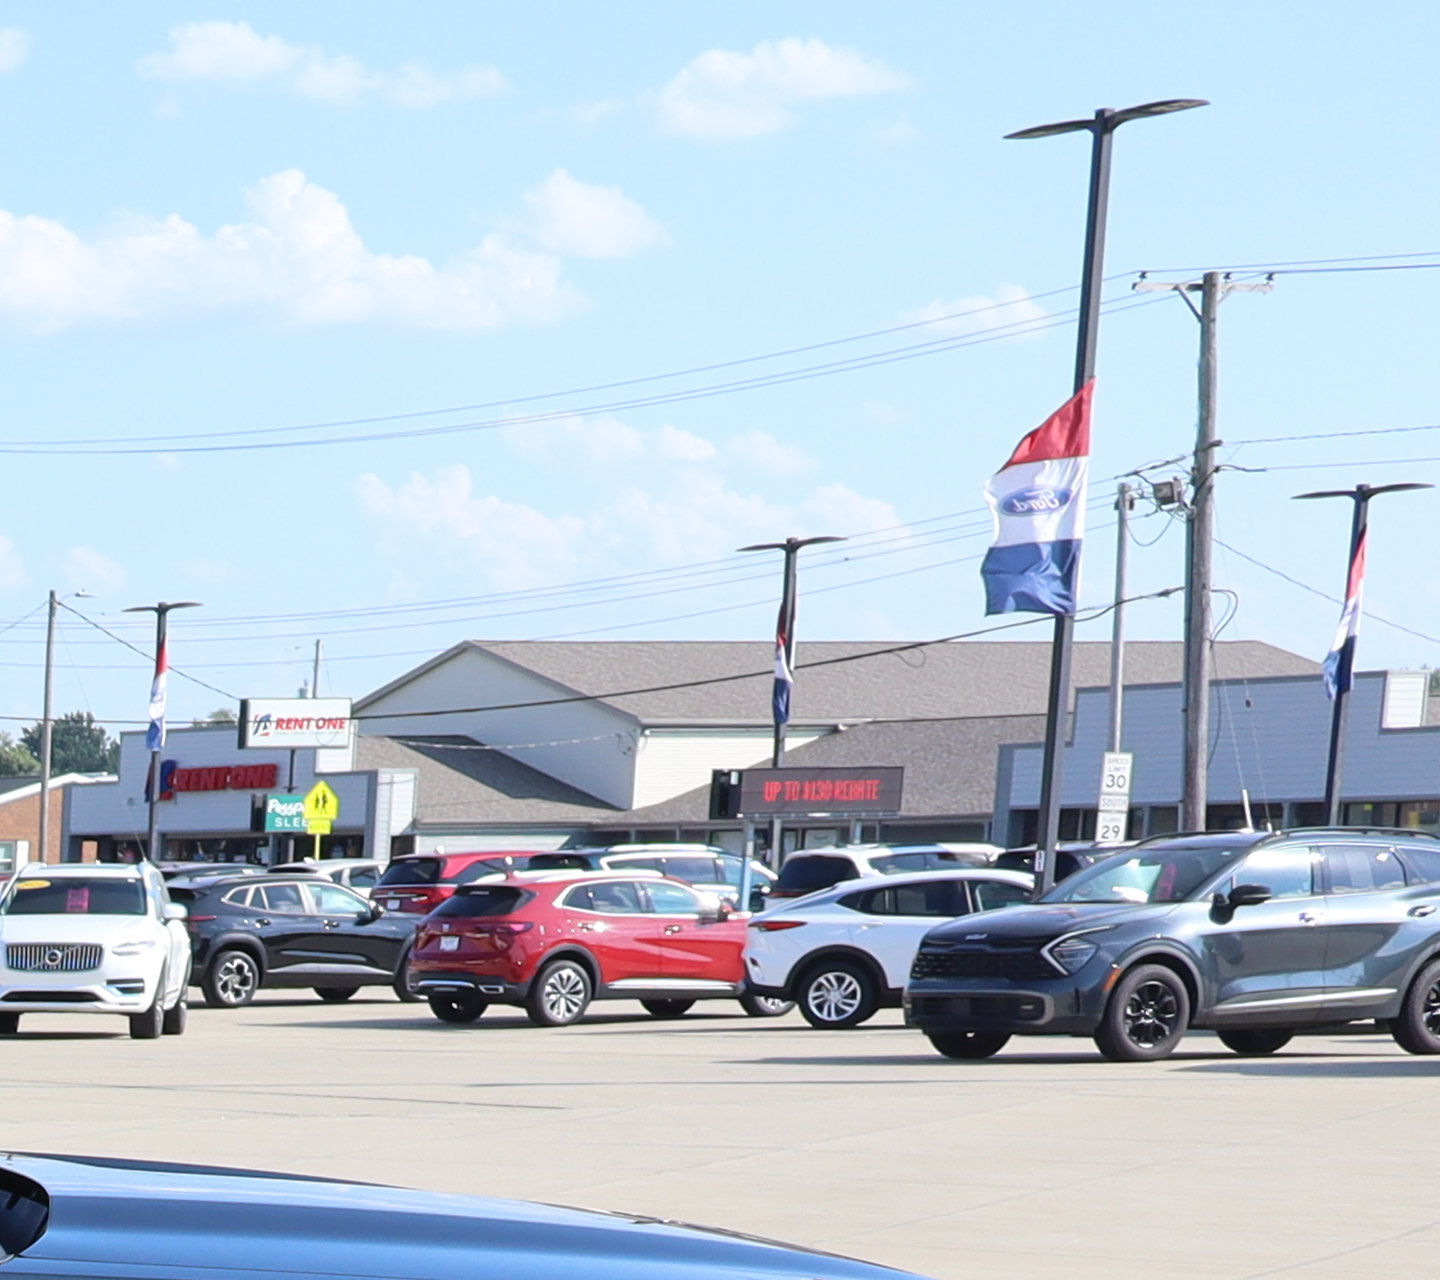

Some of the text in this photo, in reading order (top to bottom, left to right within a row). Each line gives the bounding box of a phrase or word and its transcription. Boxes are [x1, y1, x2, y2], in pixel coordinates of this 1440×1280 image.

[274, 716, 348, 731] RENT ONE
[175, 763, 278, 792] RENT ONE
[1105, 774, 1127, 788] 30
[763, 780, 782, 802] UP
[783, 780, 800, 801] TO
[274, 817, 308, 828] SLEE
[1100, 825, 1121, 840] 29
